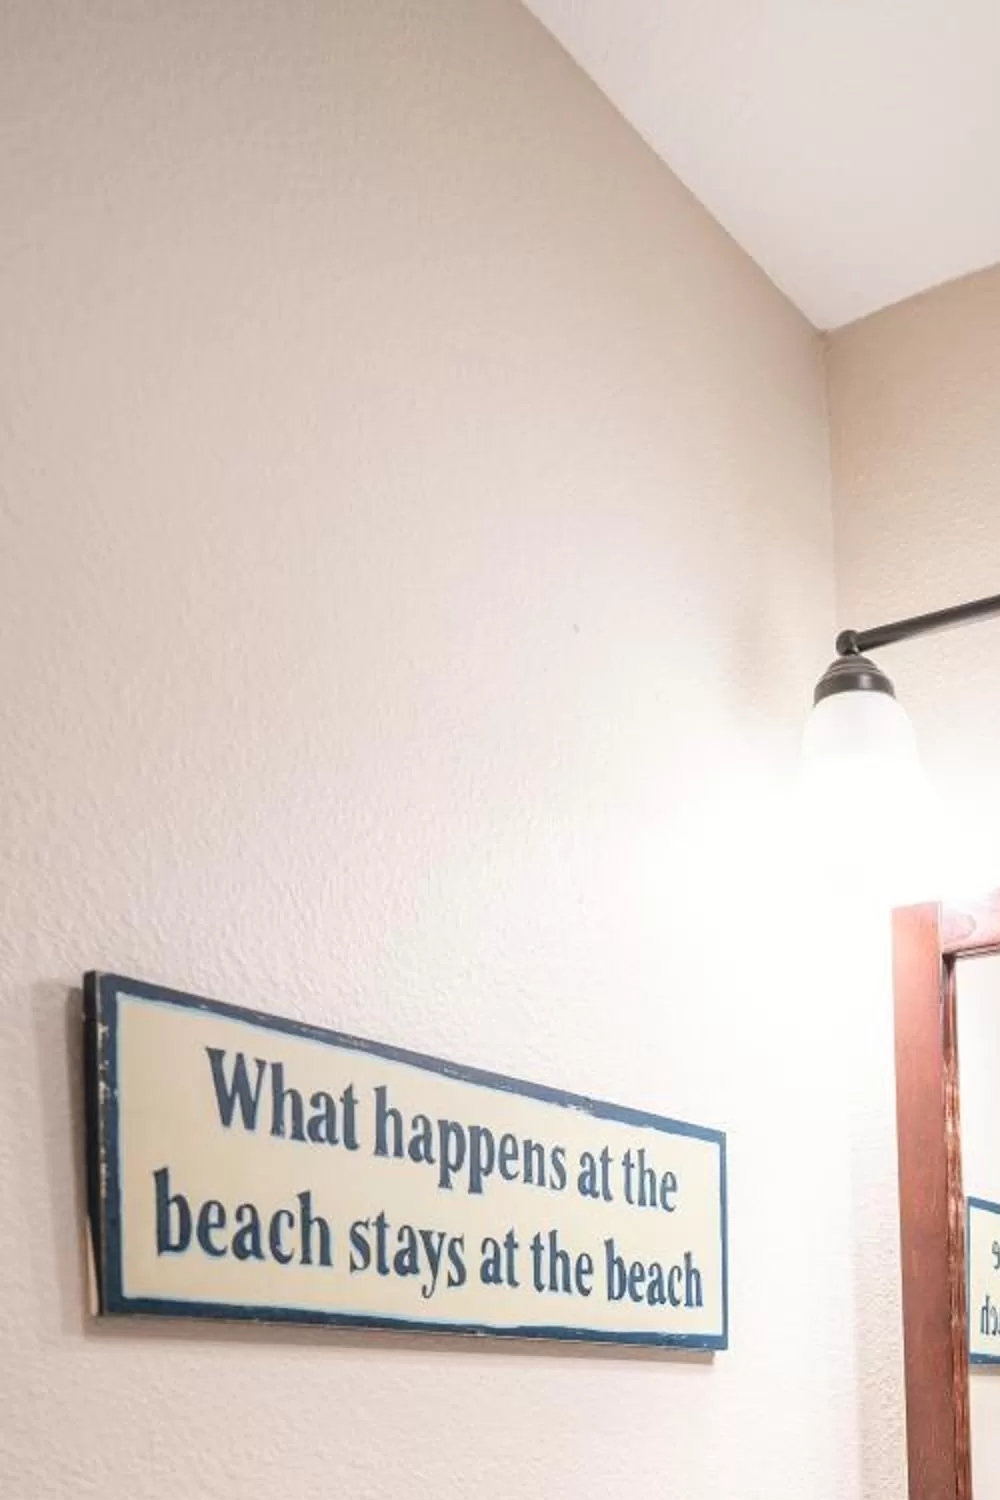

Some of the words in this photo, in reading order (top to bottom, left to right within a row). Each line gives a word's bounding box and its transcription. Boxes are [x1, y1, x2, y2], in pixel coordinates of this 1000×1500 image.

[206, 1046, 360, 1150] What
[374, 1085, 566, 1195] happens
[578, 1145, 614, 1200] at
[621, 1148, 678, 1211] the
[154, 1168, 332, 1267] beach
[349, 1210, 467, 1298] stays
[479, 1228, 519, 1289] at
[531, 1231, 593, 1296] the
[604, 1239, 704, 1307] beach
